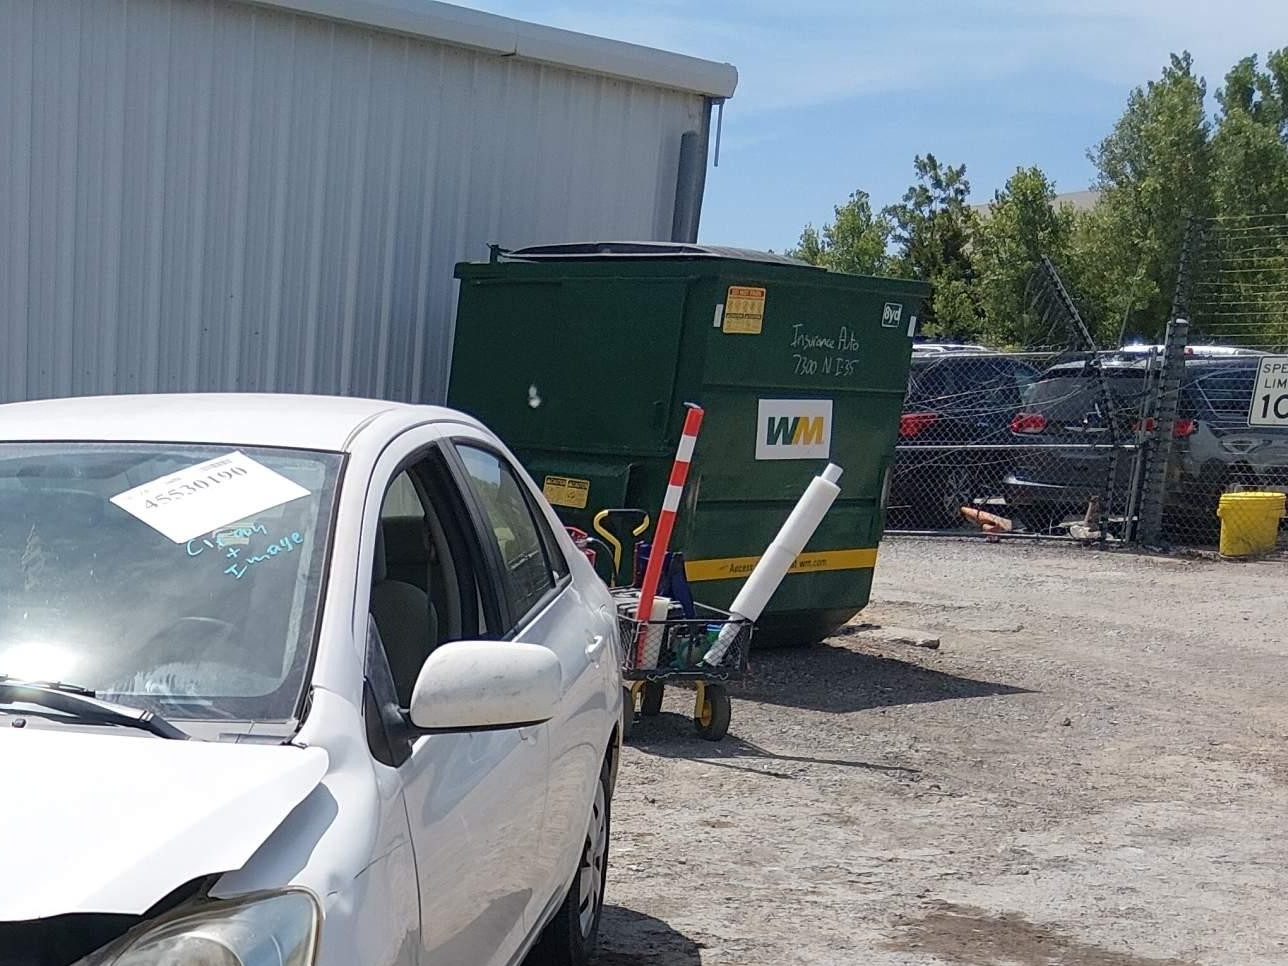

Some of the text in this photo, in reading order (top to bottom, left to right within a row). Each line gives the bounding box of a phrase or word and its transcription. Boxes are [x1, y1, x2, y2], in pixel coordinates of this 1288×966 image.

[884, 305, 901, 324] 8yd
[837, 326, 860, 351] Auto
[822, 356, 833, 374] N
[766, 416, 825, 446] WM
[145, 466, 248, 509] 45530190
